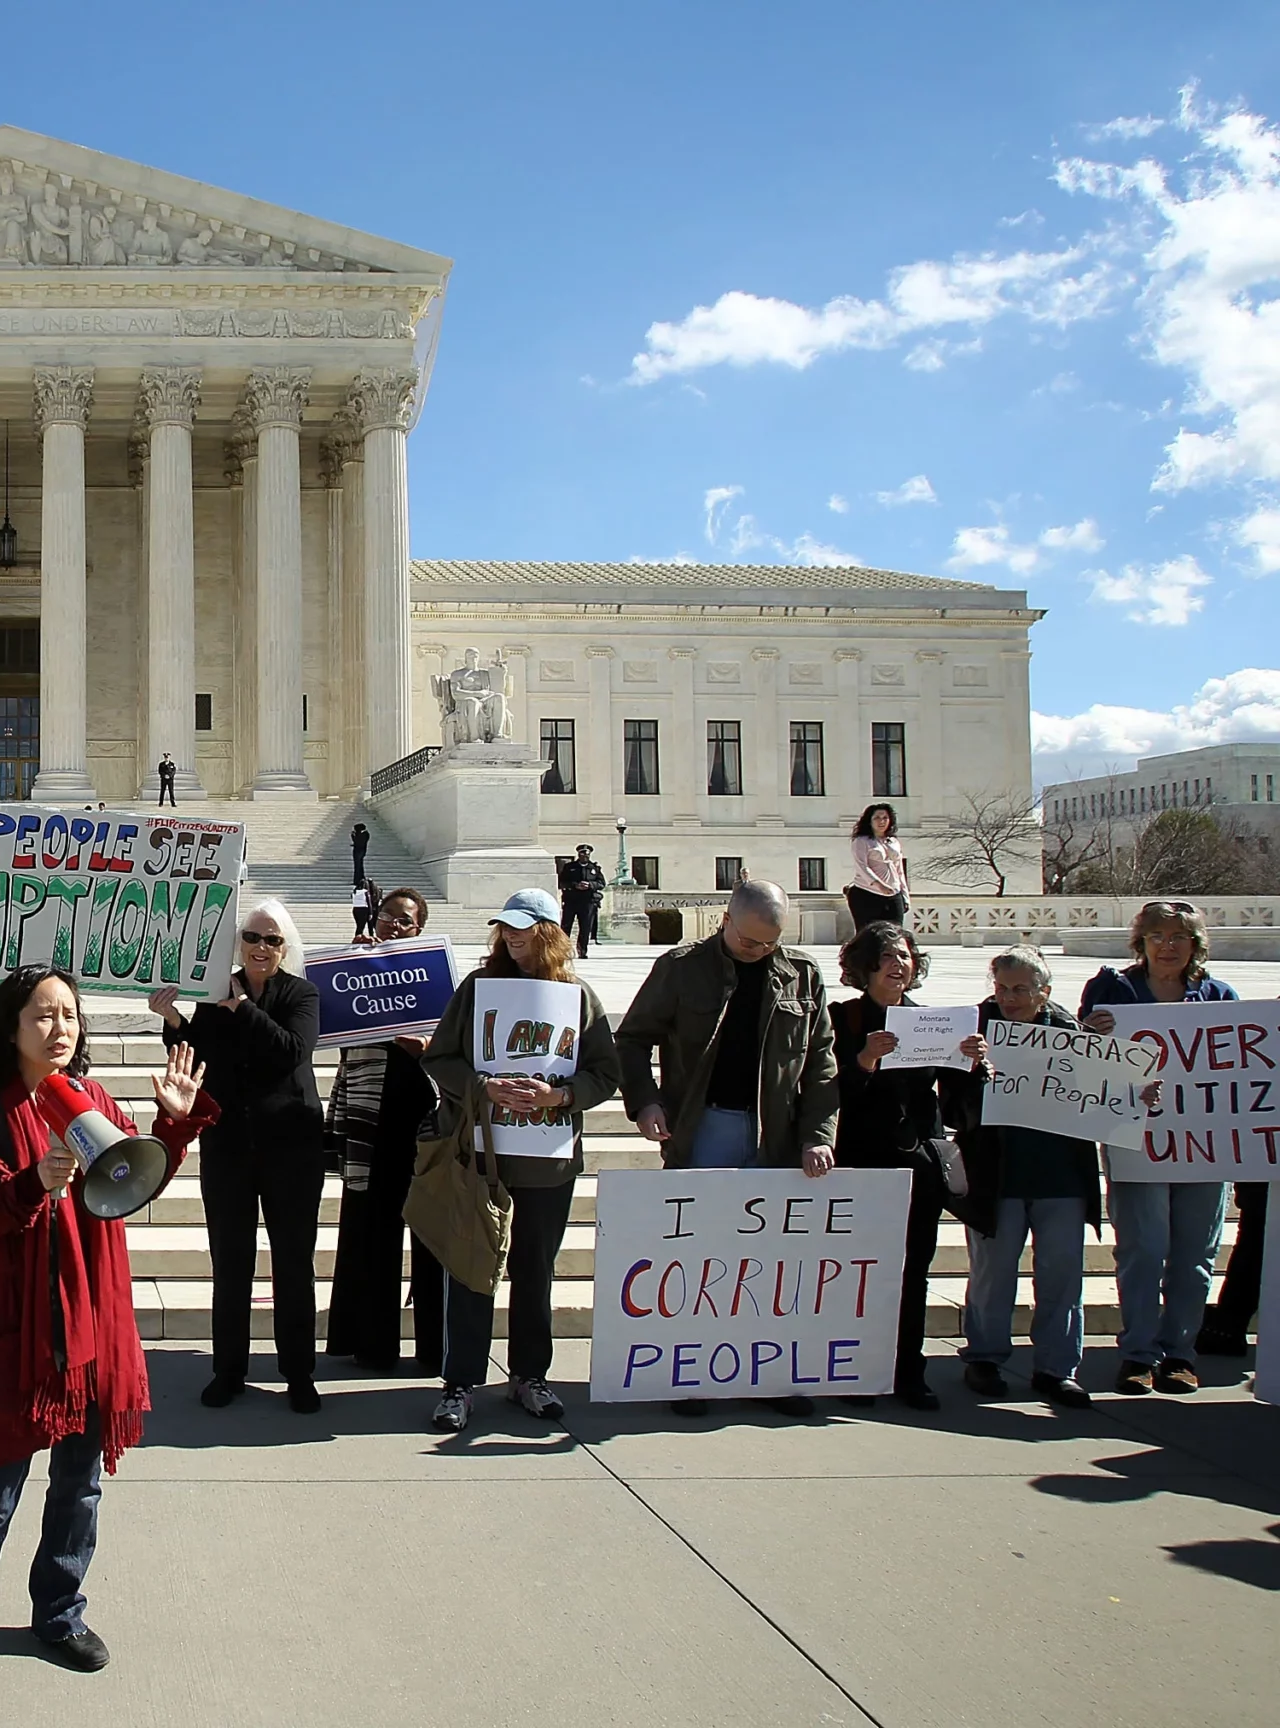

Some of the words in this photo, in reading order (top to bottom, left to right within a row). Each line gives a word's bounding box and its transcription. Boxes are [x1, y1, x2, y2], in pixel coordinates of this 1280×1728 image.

[32, 315, 105, 332] UNDER
[116, 315, 159, 331] LAW
[143, 827, 224, 880] SEE
[332, 967, 429, 993] Common
[352, 994, 417, 1016] Cause
[483, 1009, 498, 1062] I
[506, 1020, 555, 1053] AM
[554, 1026, 576, 1061] A
[934, 1026, 953, 1034] Right
[993, 1021, 1160, 1077] DEMOCRACY
[1130, 1023, 1280, 1073] OVER
[1041, 1075, 1140, 1120] People!
[1147, 1081, 1276, 1117] ITIZ
[663, 1197, 696, 1239] I
[736, 1197, 854, 1235] SEE
[621, 1257, 878, 1318] CORRUPT
[623, 1340, 860, 1388] PEOPLE
